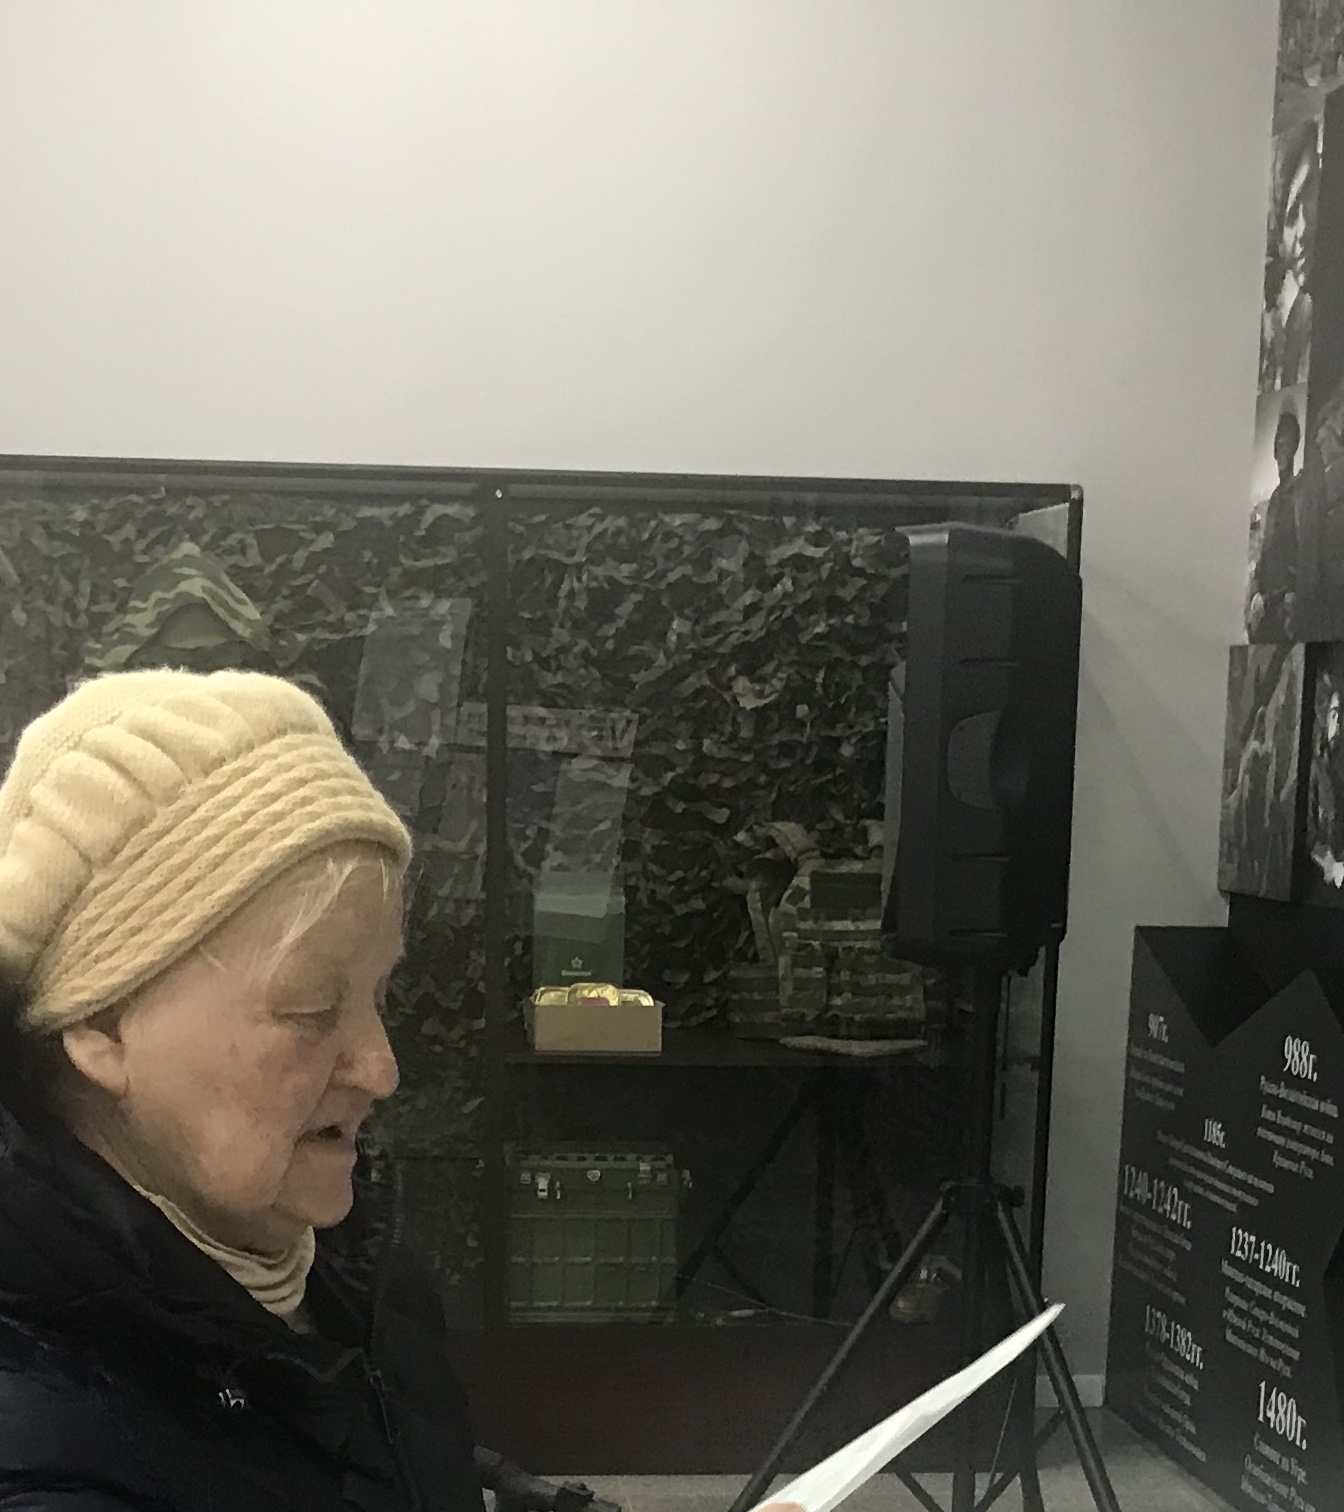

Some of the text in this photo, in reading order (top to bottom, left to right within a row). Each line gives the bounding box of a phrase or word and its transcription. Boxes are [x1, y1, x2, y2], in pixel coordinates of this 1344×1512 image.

[1282, 1034, 1318, 1083] 988г.
[1229, 1225, 1301, 1288] 1237-1240гг.
[1257, 1379, 1307, 1451] 1480г.
